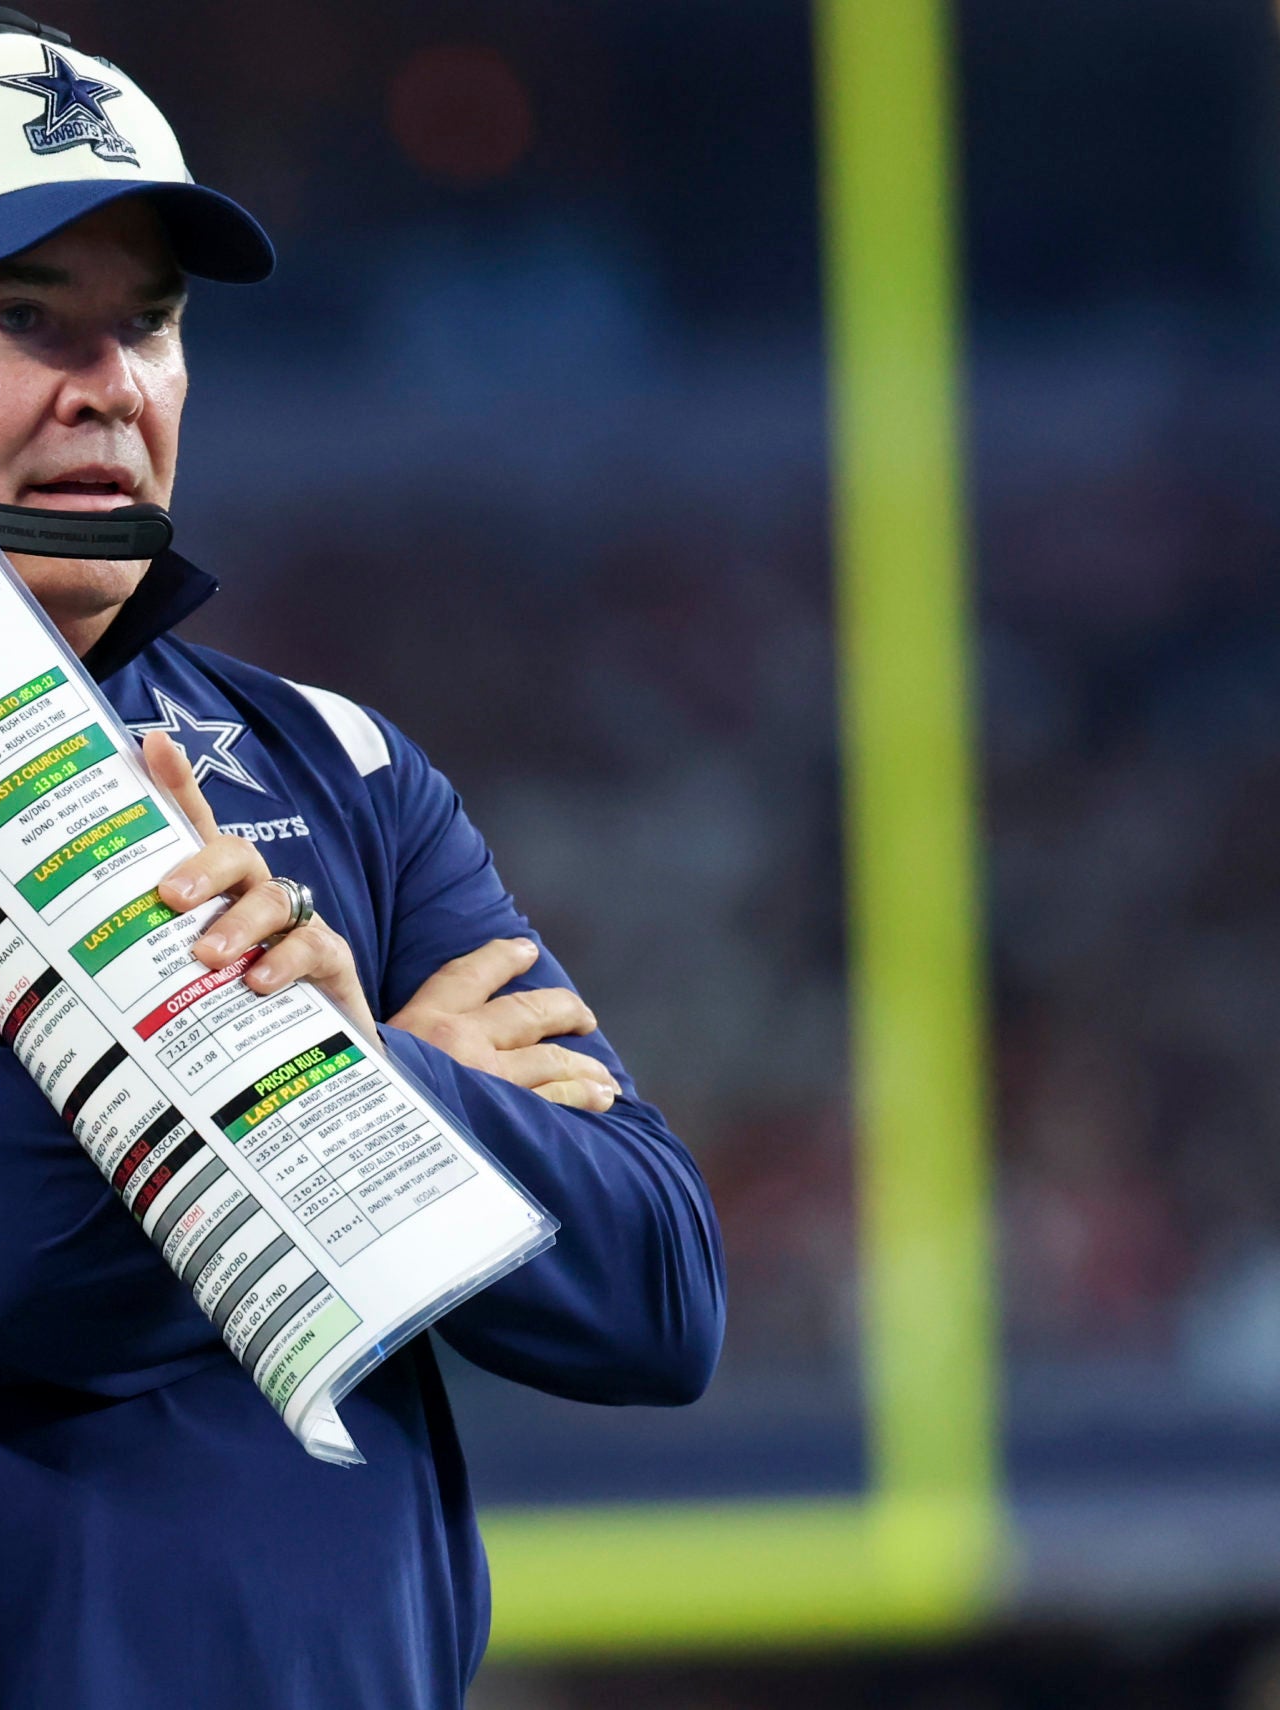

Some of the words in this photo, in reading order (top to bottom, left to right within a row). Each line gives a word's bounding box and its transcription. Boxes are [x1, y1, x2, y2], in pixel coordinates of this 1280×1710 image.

[31, 120, 100, 147] COWBOYS
[2, 694, 20, 709] TO
[16, 687, 34, 701] :05
[29, 681, 44, 694] to
[38, 673, 56, 688] :12
[17, 704, 39, 721] ELVIS
[35, 696, 52, 710] STIR
[4, 732, 28, 751] RUSH
[24, 721, 46, 737] ELVIS
[47, 709, 67, 724] THIEF
[20, 748, 64, 780] CHURCH
[59, 733, 90, 755] CLOCK
[31, 777, 52, 794] :13
[47, 770, 64, 784] to
[59, 761, 78, 776] :18
[17, 798, 52, 824] NI/DNO
[53, 783, 75, 800] RUSH
[72, 774, 92, 788] ELVIS
[88, 766, 104, 779] STIR
[20, 817, 56, 845] NI/DNO
[57, 801, 79, 819] RUSH
[81, 789, 101, 804] ELVIS
[102, 778, 120, 792] THIEF
[65, 816, 90, 834] CLOCK
[87, 804, 109, 820] ALLEN
[33, 855, 64, 881] LAST
[70, 823, 113, 853] CHURCH
[108, 803, 148, 830] THUNDER
[217, 815, 310, 842] WBOYS
[91, 844, 110, 860] FG
[92, 866, 109, 880] 3RD
[107, 853, 131, 871] DOWN
[128, 844, 147, 858] CALLS
[145, 912, 163, 926] :05
[83, 922, 115, 950] LAST
[145, 926, 173, 946] BANDIT
[151, 943, 180, 964] NI/DNO
[157, 956, 187, 978] NI/DNO
[3, 989, 17, 1004] NO
[14, 975, 30, 993] FG)
[165, 981, 206, 1014] OZONE
[232, 1013, 257, 1031] BANDIT
[270, 993, 294, 1010] FUNNEL
[28, 1033, 45, 1051] Y-GO
[156, 1027, 174, 1043] 1-6
[165, 1039, 188, 1058] 7-12
[45, 1048, 77, 1092] WESTBROOK
[184, 1060, 204, 1077] +13
[253, 1062, 300, 1096] PRISON
[294, 1046, 327, 1070] RULES
[243, 1094, 282, 1126] LAST
[278, 1076, 311, 1100] PLAY
[321, 1060, 336, 1074] to
[297, 1089, 324, 1108] BANDIT
[337, 1067, 362, 1085] FUNNEL
[298, 1101, 339, 1129] BANDIT-ODD
[335, 1088, 360, 1106] STRONG
[356, 1075, 383, 1094] FIREBALL
[91, 1120, 103, 1135] GO
[99, 1089, 131, 1124] (Y-FIND)
[123, 1099, 166, 1143] Z-BASELINE
[317, 1119, 344, 1138] BANDIT
[357, 1092, 389, 1114] CABERNET
[101, 1125, 119, 1144] FIND
[240, 1134, 259, 1150] +34
[256, 1127, 268, 1139] to
[266, 1117, 283, 1131] +13
[321, 1137, 348, 1156] DNO/NI
[373, 1110, 393, 1125] LOOSE
[347, 1147, 365, 1161] 911
[364, 1132, 390, 1151] DNO/NI
[390, 1121, 409, 1135] SINK
[253, 1148, 271, 1164] +35
[268, 1140, 280, 1153] to
[356, 1160, 378, 1176] (RED)
[374, 1148, 397, 1165] ALLEN
[397, 1132, 423, 1151] DOLLAR
[396, 1150, 429, 1173] HURRICANE
[126, 1172, 142, 1192] PASS
[283, 1163, 296, 1175] to
[299, 1184, 312, 1196] to
[310, 1173, 328, 1188] +21
[366, 1193, 394, 1213] DNO/NI
[393, 1180, 413, 1196] SLANT
[409, 1172, 426, 1185] TUFF
[422, 1155, 454, 1177] LIGHTNING
[300, 1201, 320, 1217] +20
[317, 1194, 330, 1206] to
[411, 1184, 441, 1205] (KODAK)
[185, 1223, 207, 1247] MIDDLE
[204, 1188, 243, 1226] (X-DETOUR)
[324, 1229, 342, 1244] +12
[339, 1222, 352, 1234] to
[165, 1225, 184, 1251] DUCKS
[200, 1252, 225, 1283] LADDER
[211, 1280, 223, 1295] GO
[219, 1251, 249, 1284] SWORD
[230, 1310, 245, 1327] RED
[241, 1292, 260, 1313] FIND
[240, 1322, 252, 1337] ALL
[248, 1311, 262, 1326] GO
[258, 1283, 288, 1313] Y-FIND
[280, 1319, 303, 1343] SPACING
[284, 1329, 316, 1363] H-TURN
[280, 1372, 298, 1395] JETER
